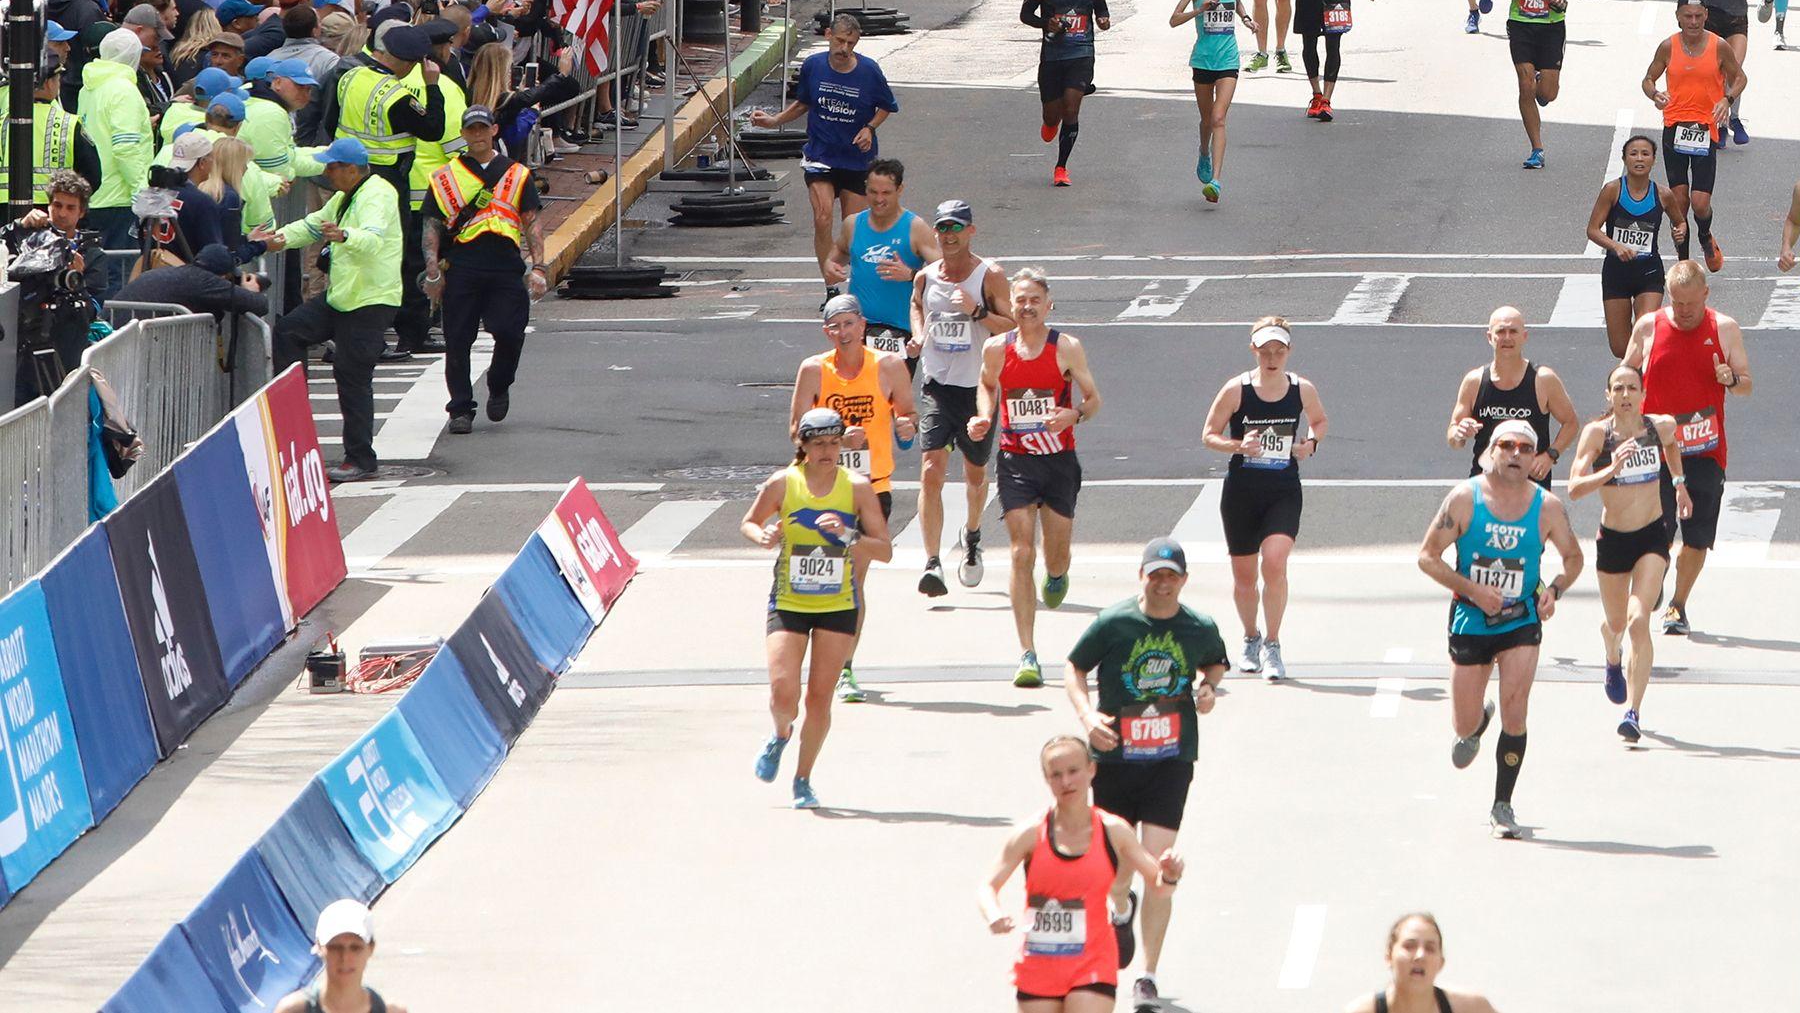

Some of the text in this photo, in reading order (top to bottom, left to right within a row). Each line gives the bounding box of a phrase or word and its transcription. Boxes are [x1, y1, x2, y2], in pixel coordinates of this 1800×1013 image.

[1207, 11, 1233, 23] 13188
[826, 98, 849, 108] TEAM
[828, 105, 856, 116] VISION
[51, 116, 61, 163] POLICE
[1680, 129, 1705, 143] 9573
[1616, 227, 1649, 248] 10532
[1011, 399, 1051, 416] 10481
[1682, 421, 1713, 442] 6722
[1261, 435, 1284, 452] 495
[1485, 522, 1526, 538] SCOTTY
[799, 557, 834, 577] 9024
[1476, 567, 1517, 591] 11371
[4, 677, 35, 732] WORLD
[16, 711, 63, 783] MARATHON
[27, 770, 64, 832] MAJORS
